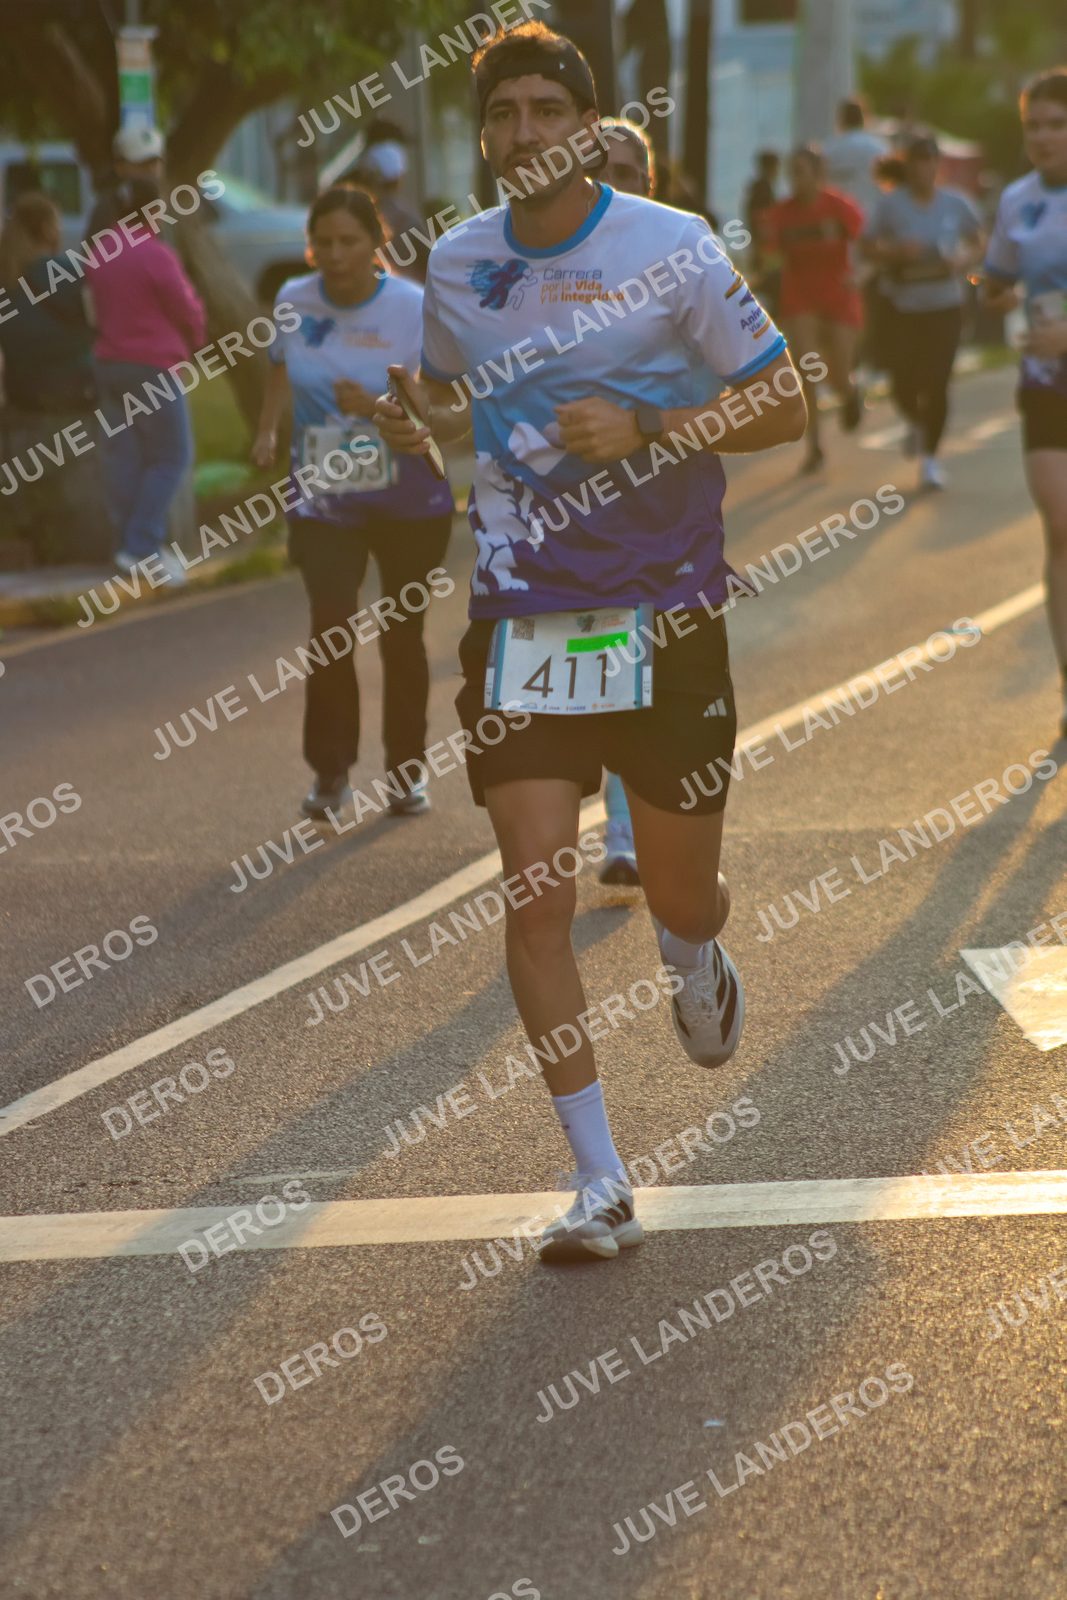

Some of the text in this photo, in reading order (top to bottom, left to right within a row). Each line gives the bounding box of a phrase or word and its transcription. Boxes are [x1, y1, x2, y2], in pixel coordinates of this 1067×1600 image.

[543, 268, 602, 281] Carrera
[575, 280, 602, 291] Vida
[521, 653, 607, 699] 411
